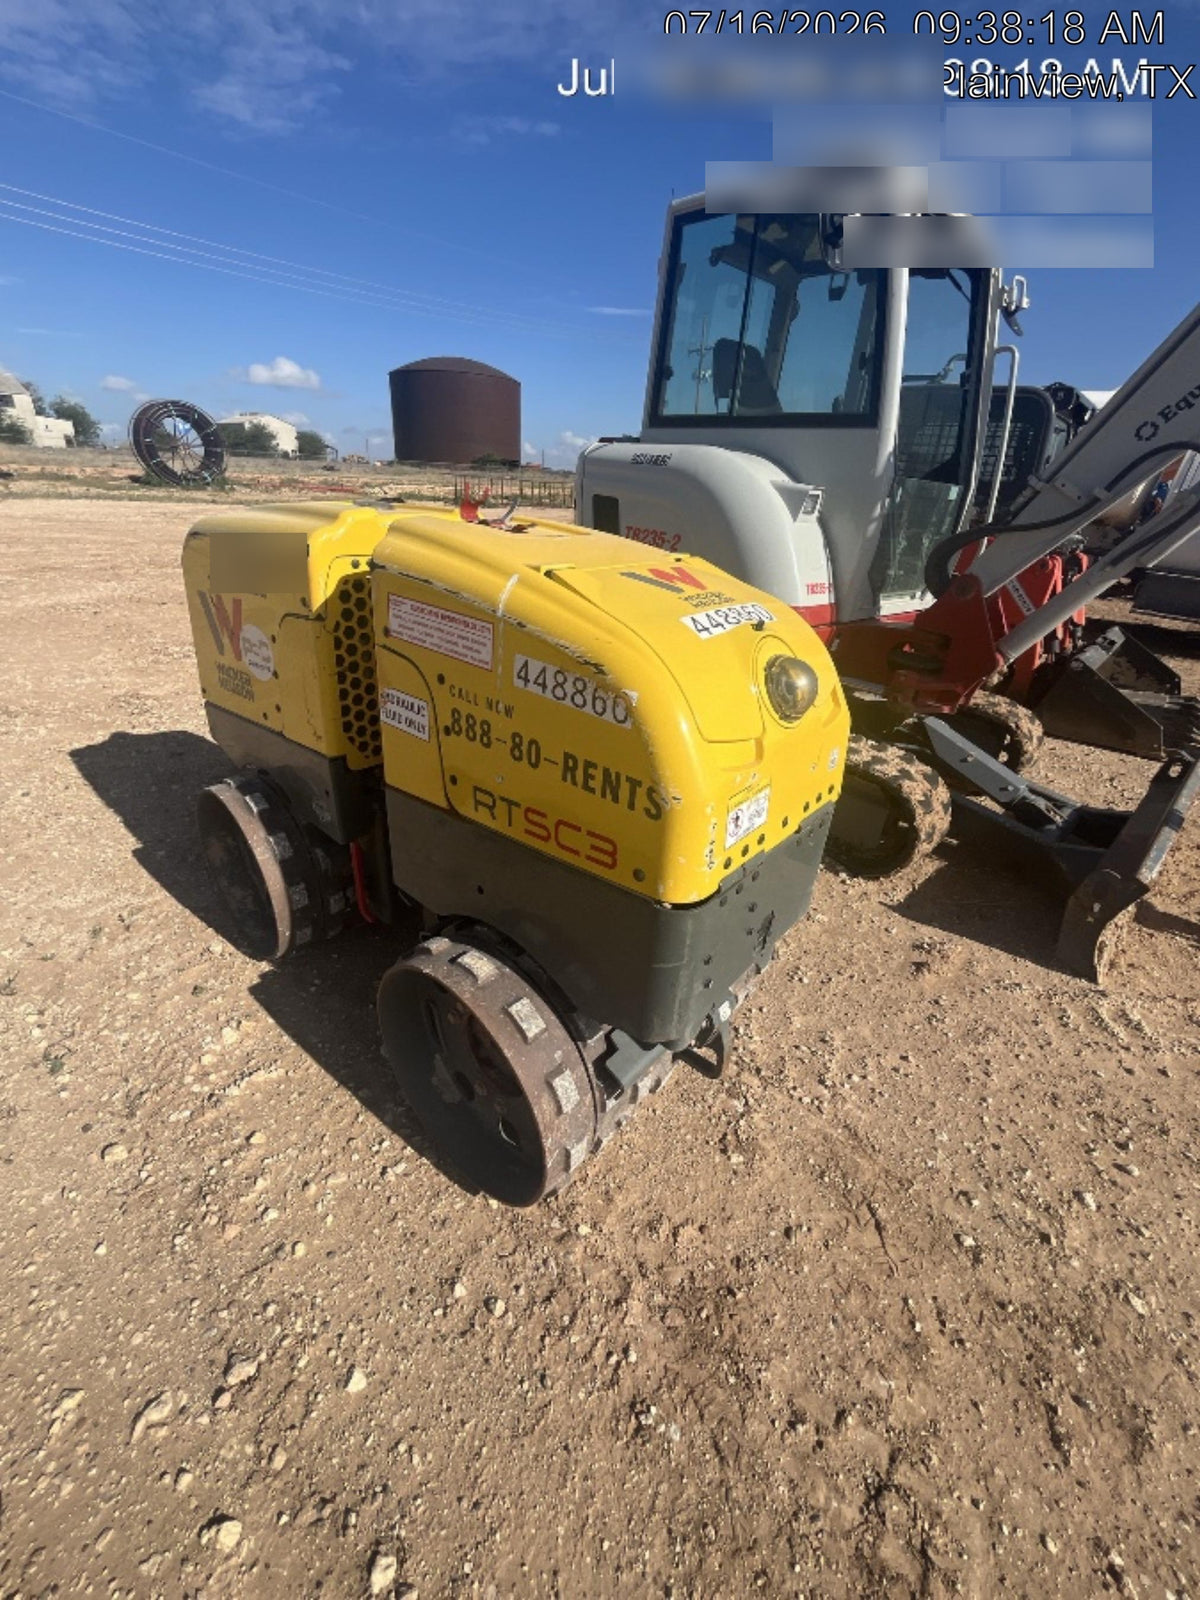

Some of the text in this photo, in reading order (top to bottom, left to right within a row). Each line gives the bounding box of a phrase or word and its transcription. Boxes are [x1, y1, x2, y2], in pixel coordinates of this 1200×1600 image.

[449, 684, 515, 719] CALL NOW
[517, 658, 630, 724] 448860
[451, 707, 663, 822] 888-80-RENTS
[472, 785, 618, 870] RTSC3
